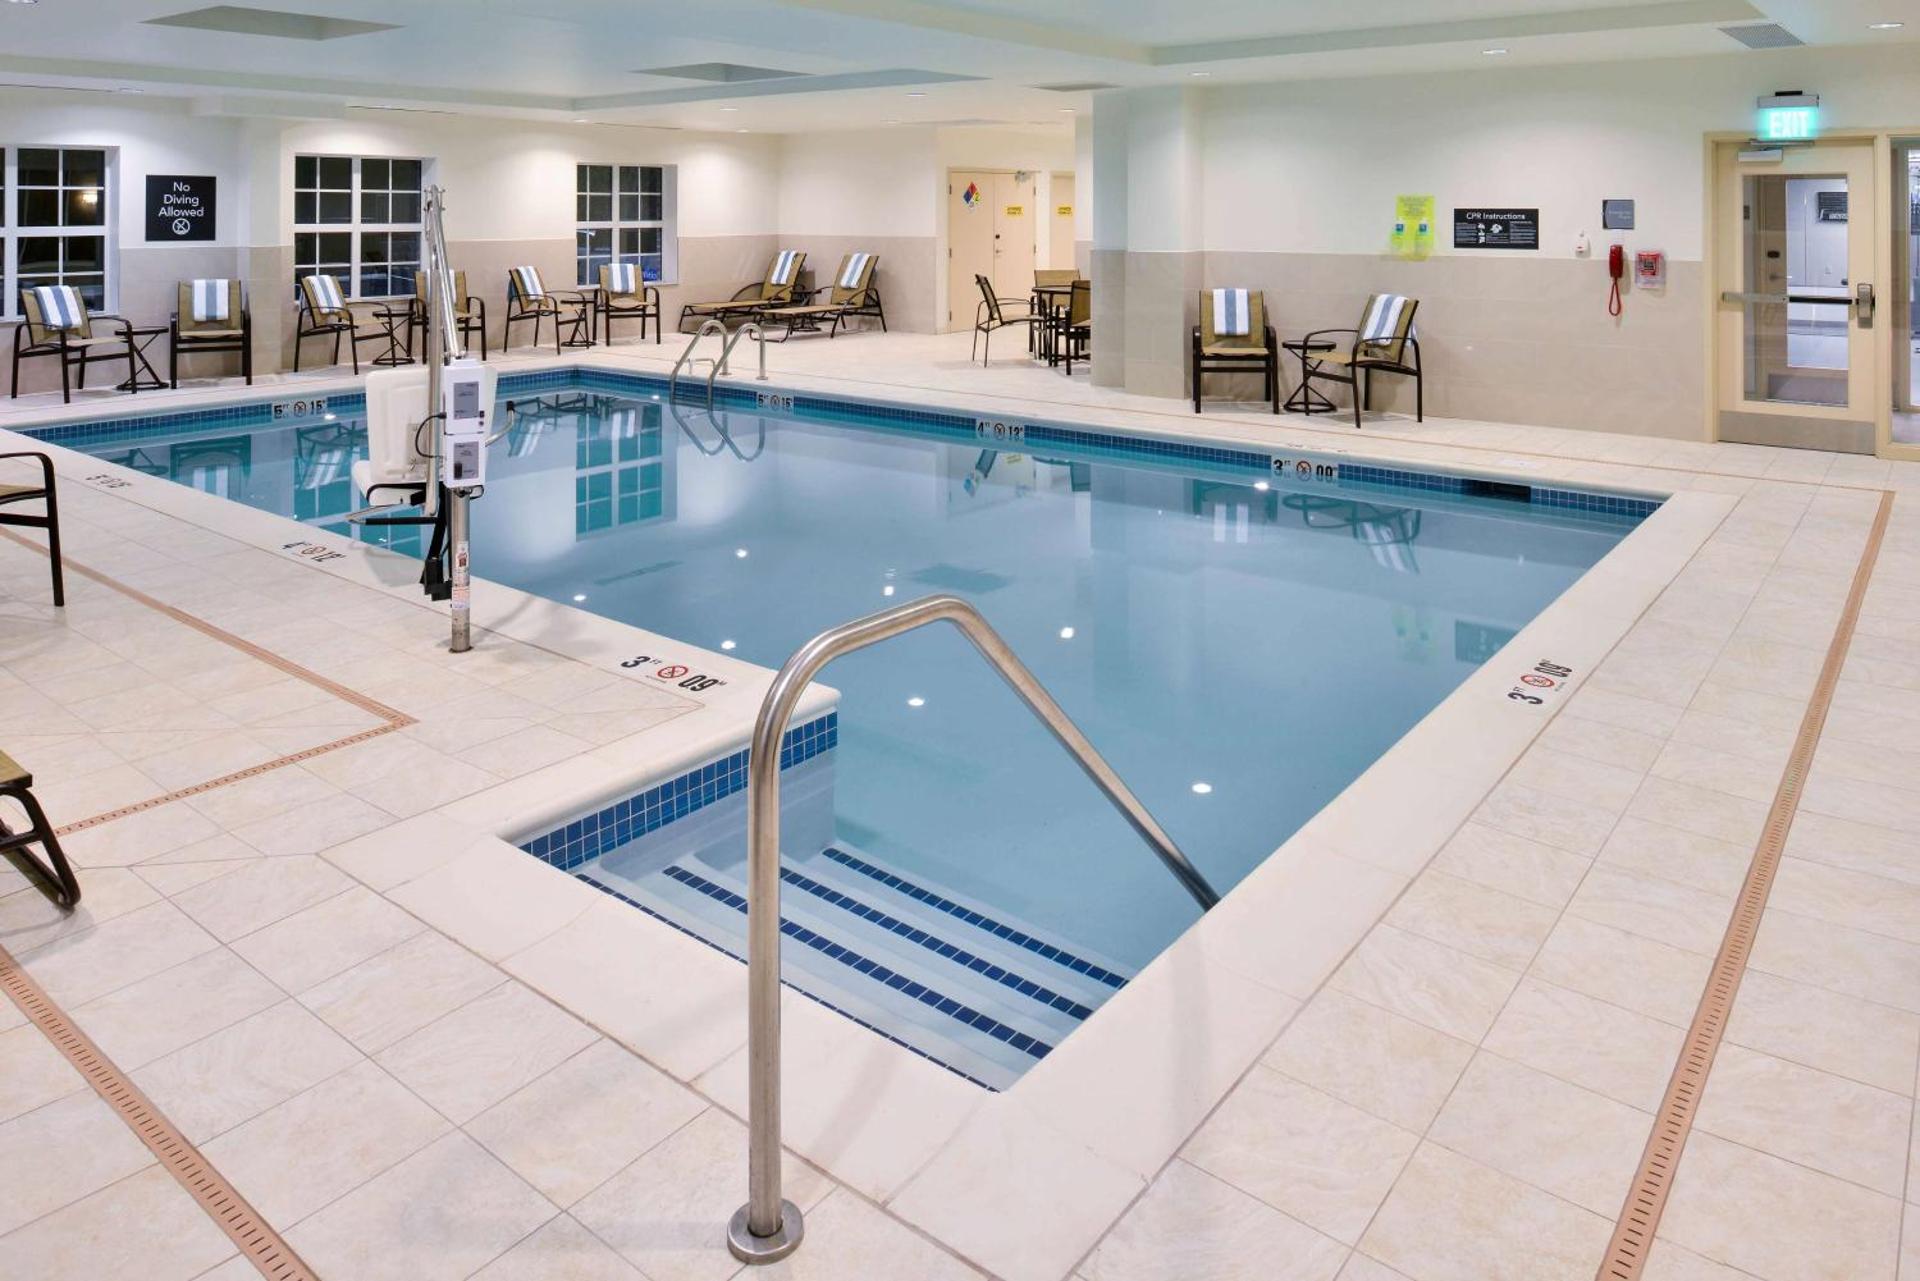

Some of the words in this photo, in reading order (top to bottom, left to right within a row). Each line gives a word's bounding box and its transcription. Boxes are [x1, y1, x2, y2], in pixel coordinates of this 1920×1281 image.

[1770, 111, 1808, 138] EXIT
[173, 181, 191, 192] No
[163, 194, 200, 207] Diving
[158, 206, 205, 217] Allowed
[1466, 212, 1482, 220] CPR
[1483, 212, 1526, 220] Instructions
